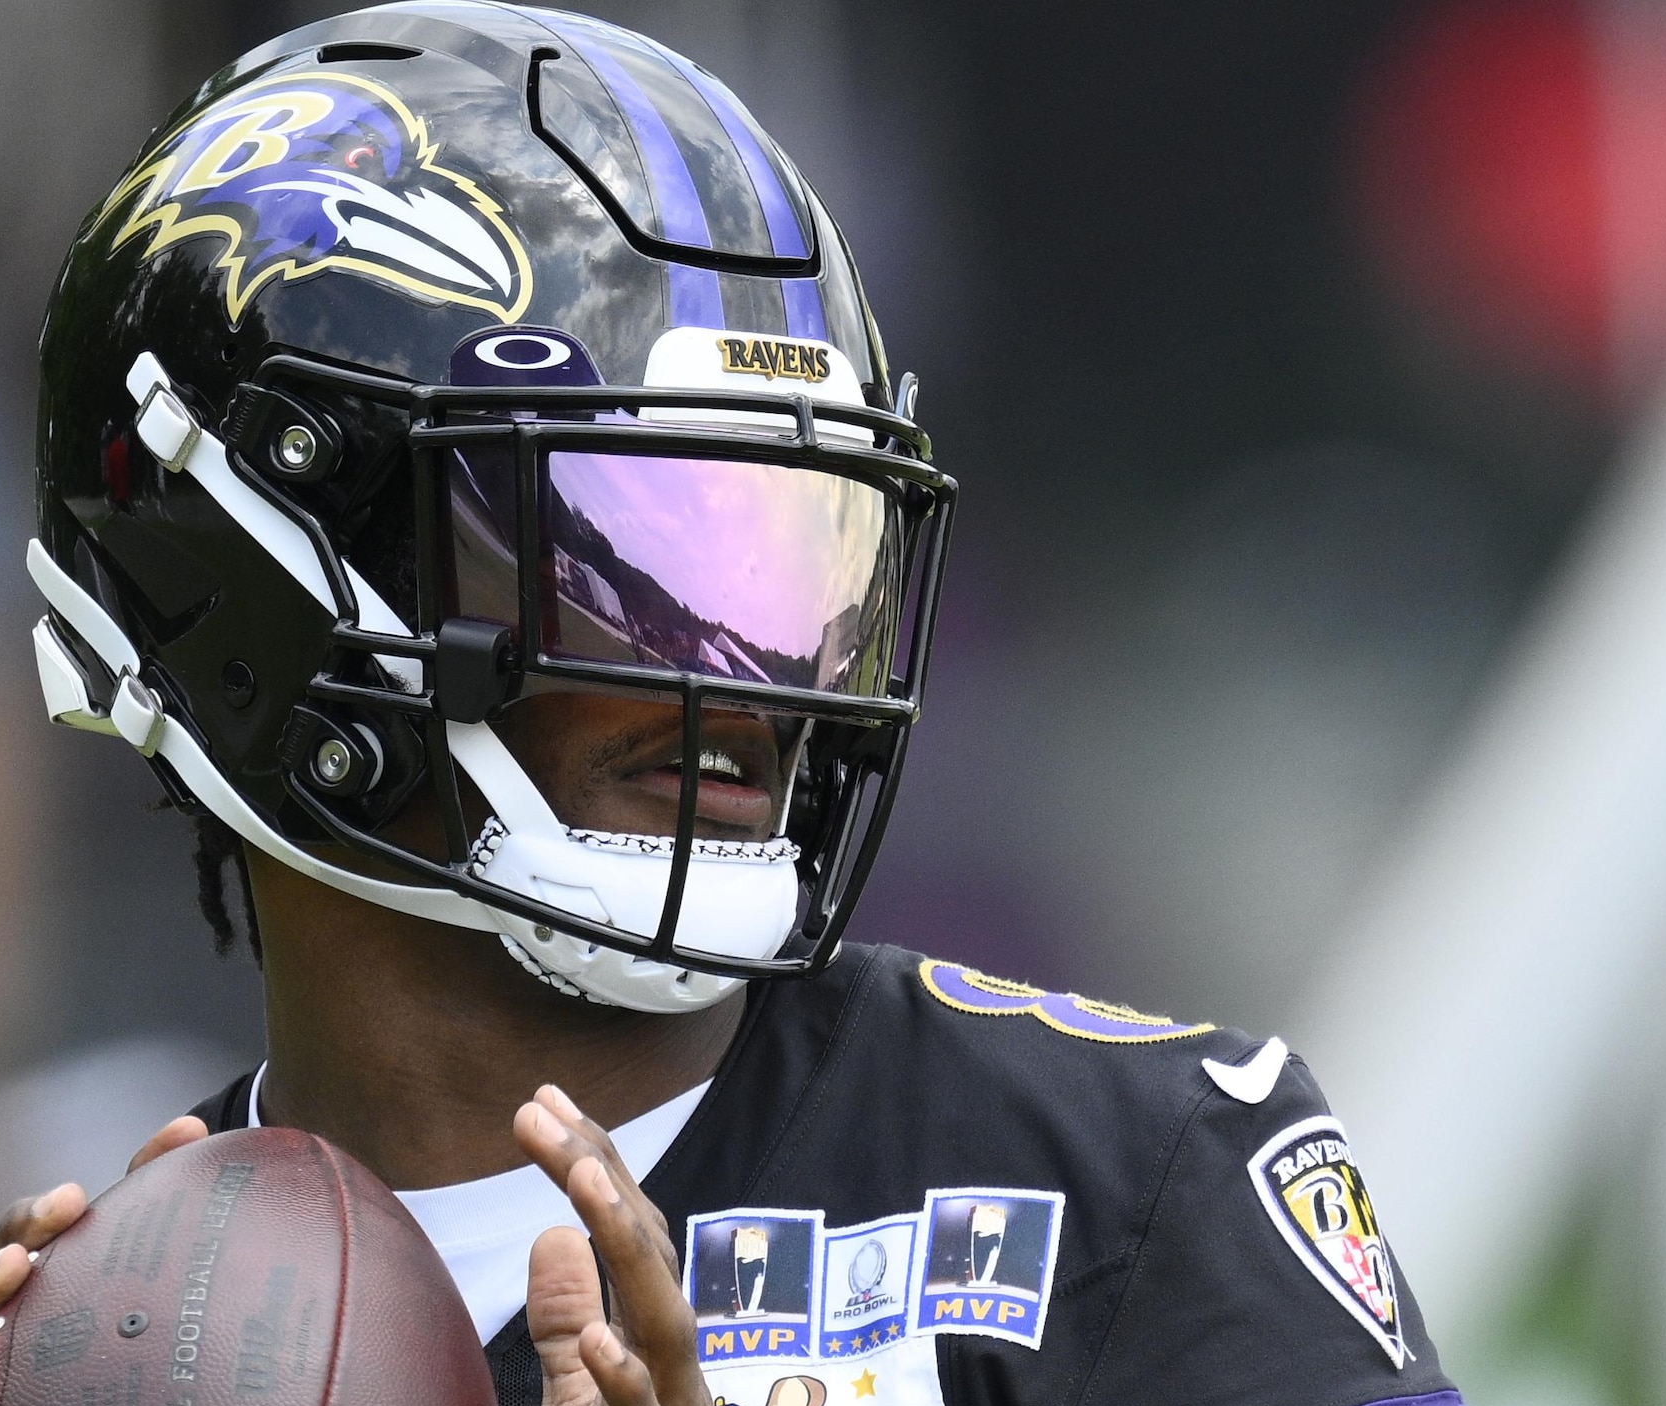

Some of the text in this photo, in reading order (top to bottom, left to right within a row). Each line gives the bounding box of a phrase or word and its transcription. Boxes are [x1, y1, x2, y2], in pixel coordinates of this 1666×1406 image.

[719, 338, 831, 382] RAVENS
[173, 1239, 218, 1382] FOOTBALL
[833, 1297, 897, 1320] PRO BOWL
[935, 1299, 1026, 1324] MVP
[706, 1328, 796, 1356] MVP
